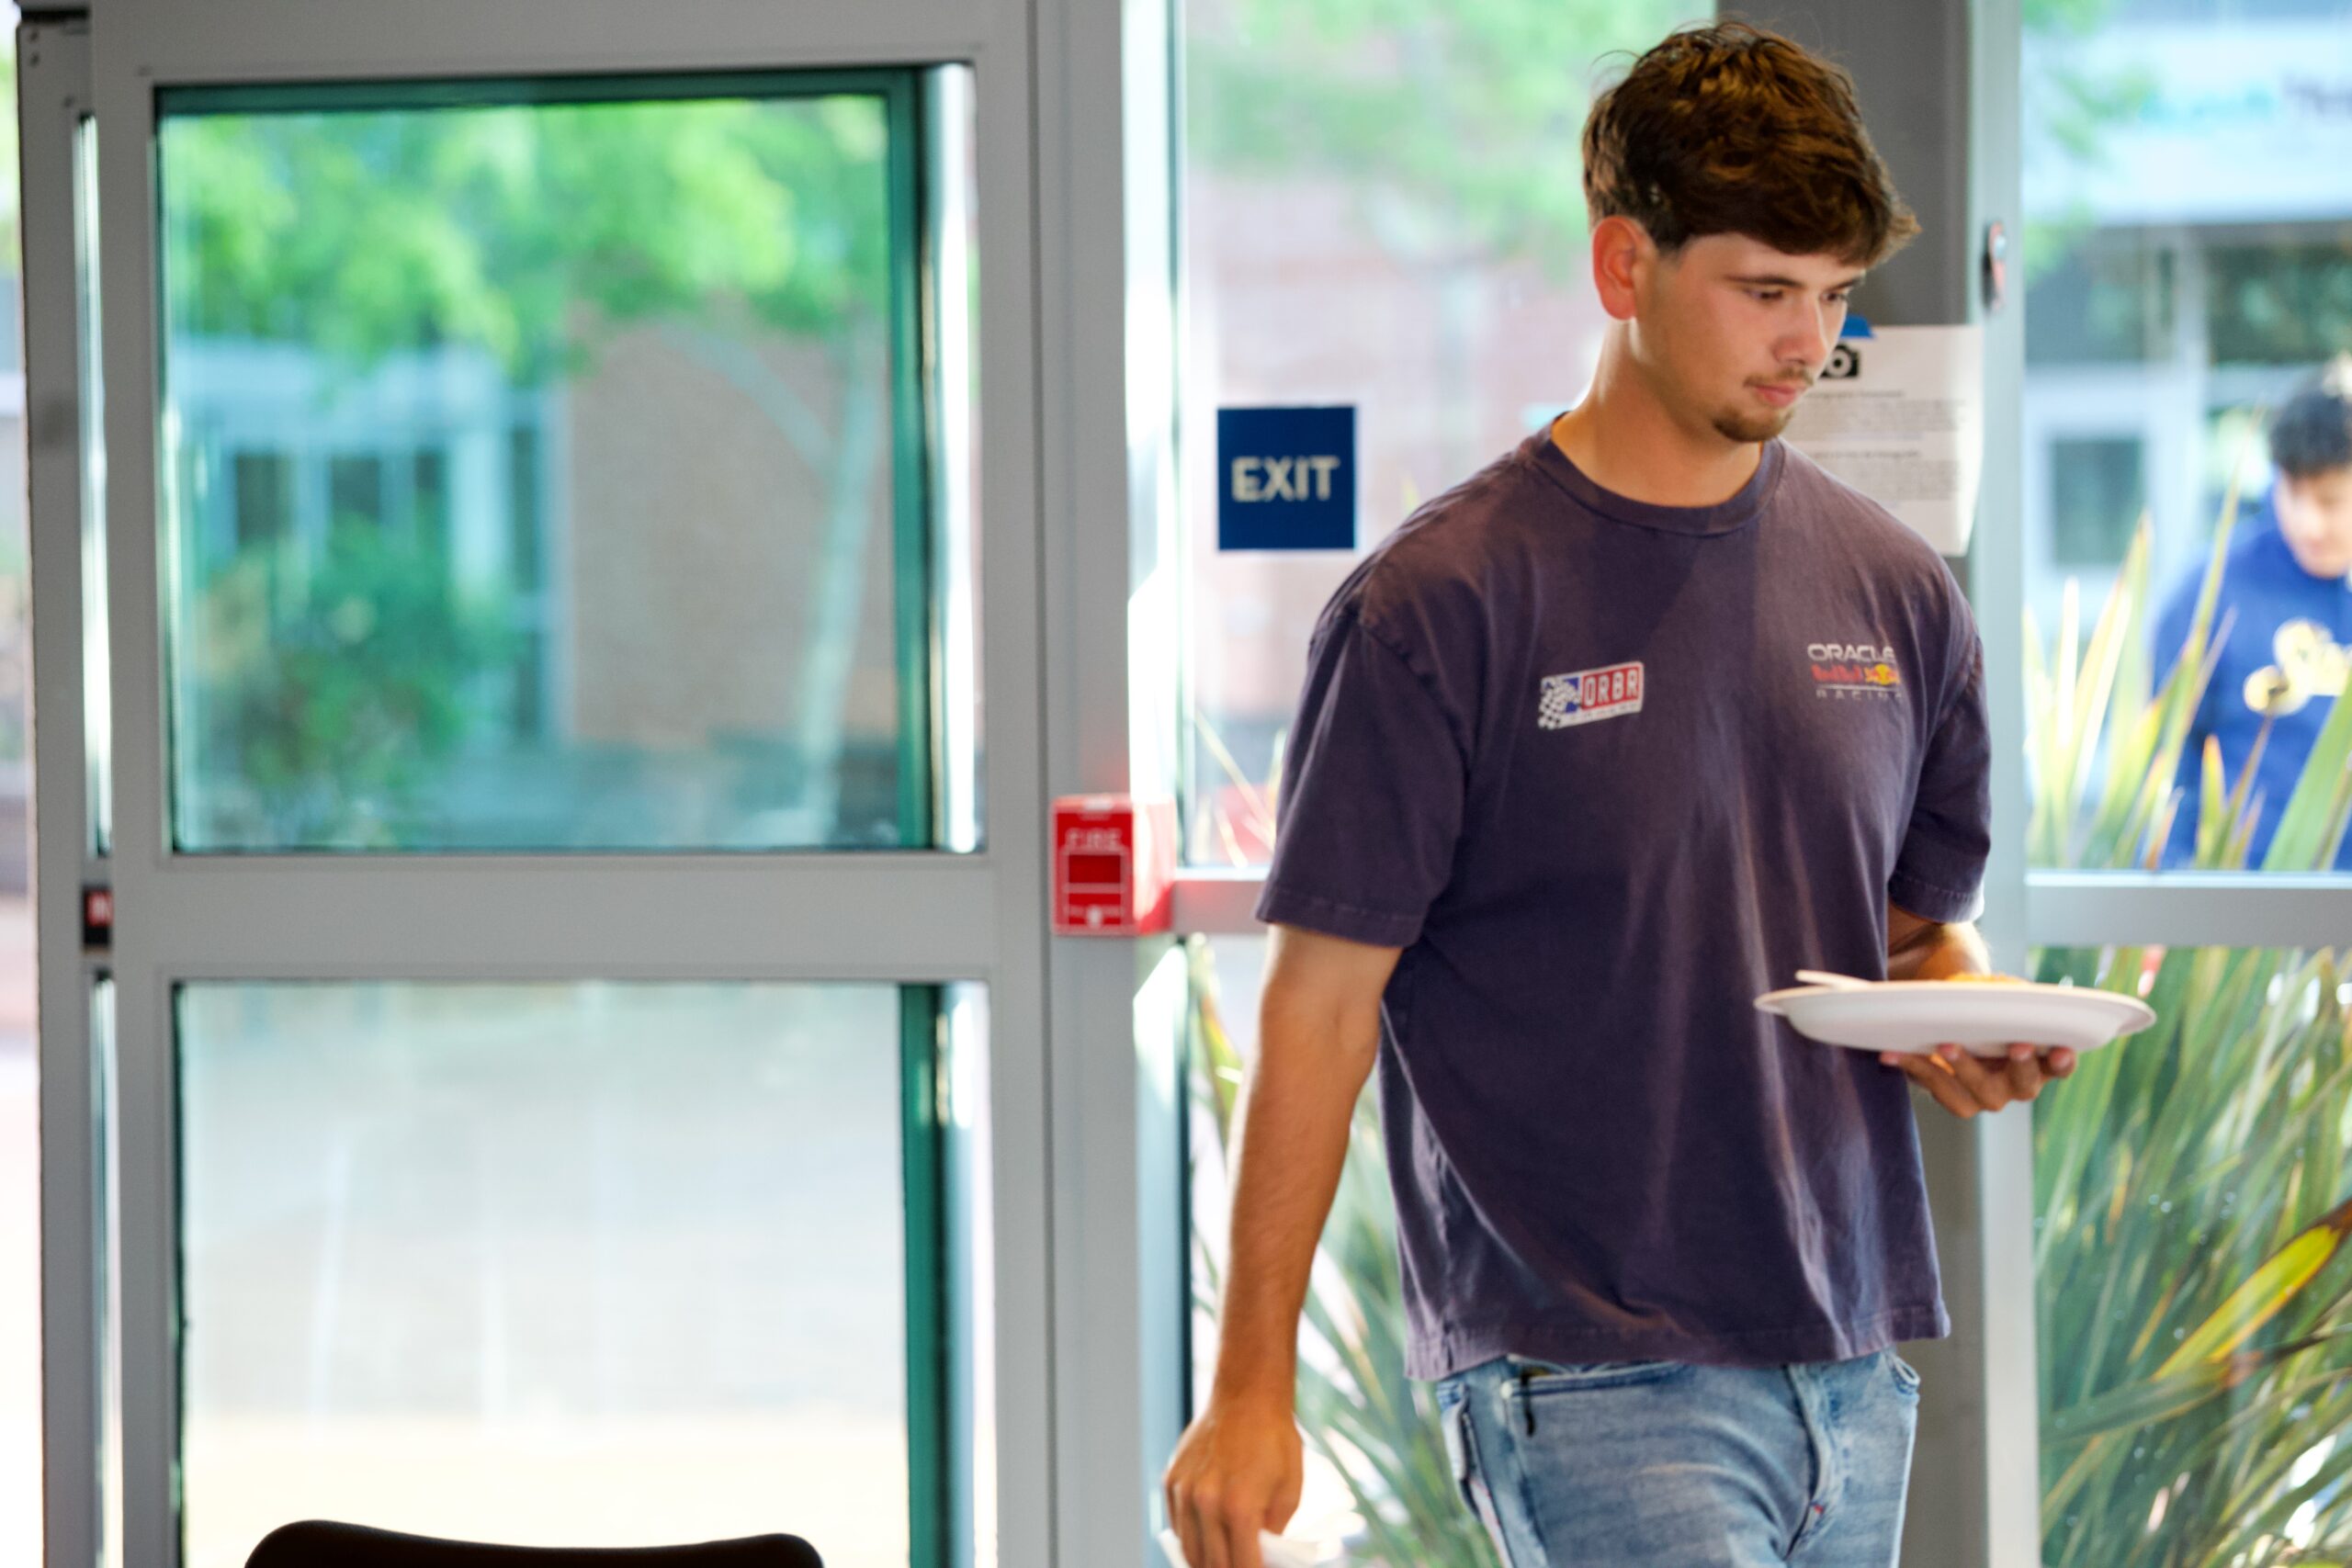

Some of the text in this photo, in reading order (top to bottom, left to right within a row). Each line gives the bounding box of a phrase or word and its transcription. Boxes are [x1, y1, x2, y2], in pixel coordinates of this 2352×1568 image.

[1231, 455, 1340, 502] EXIT
[1808, 644, 1895, 662] ORACLE
[1584, 668, 1639, 706] ORBR
